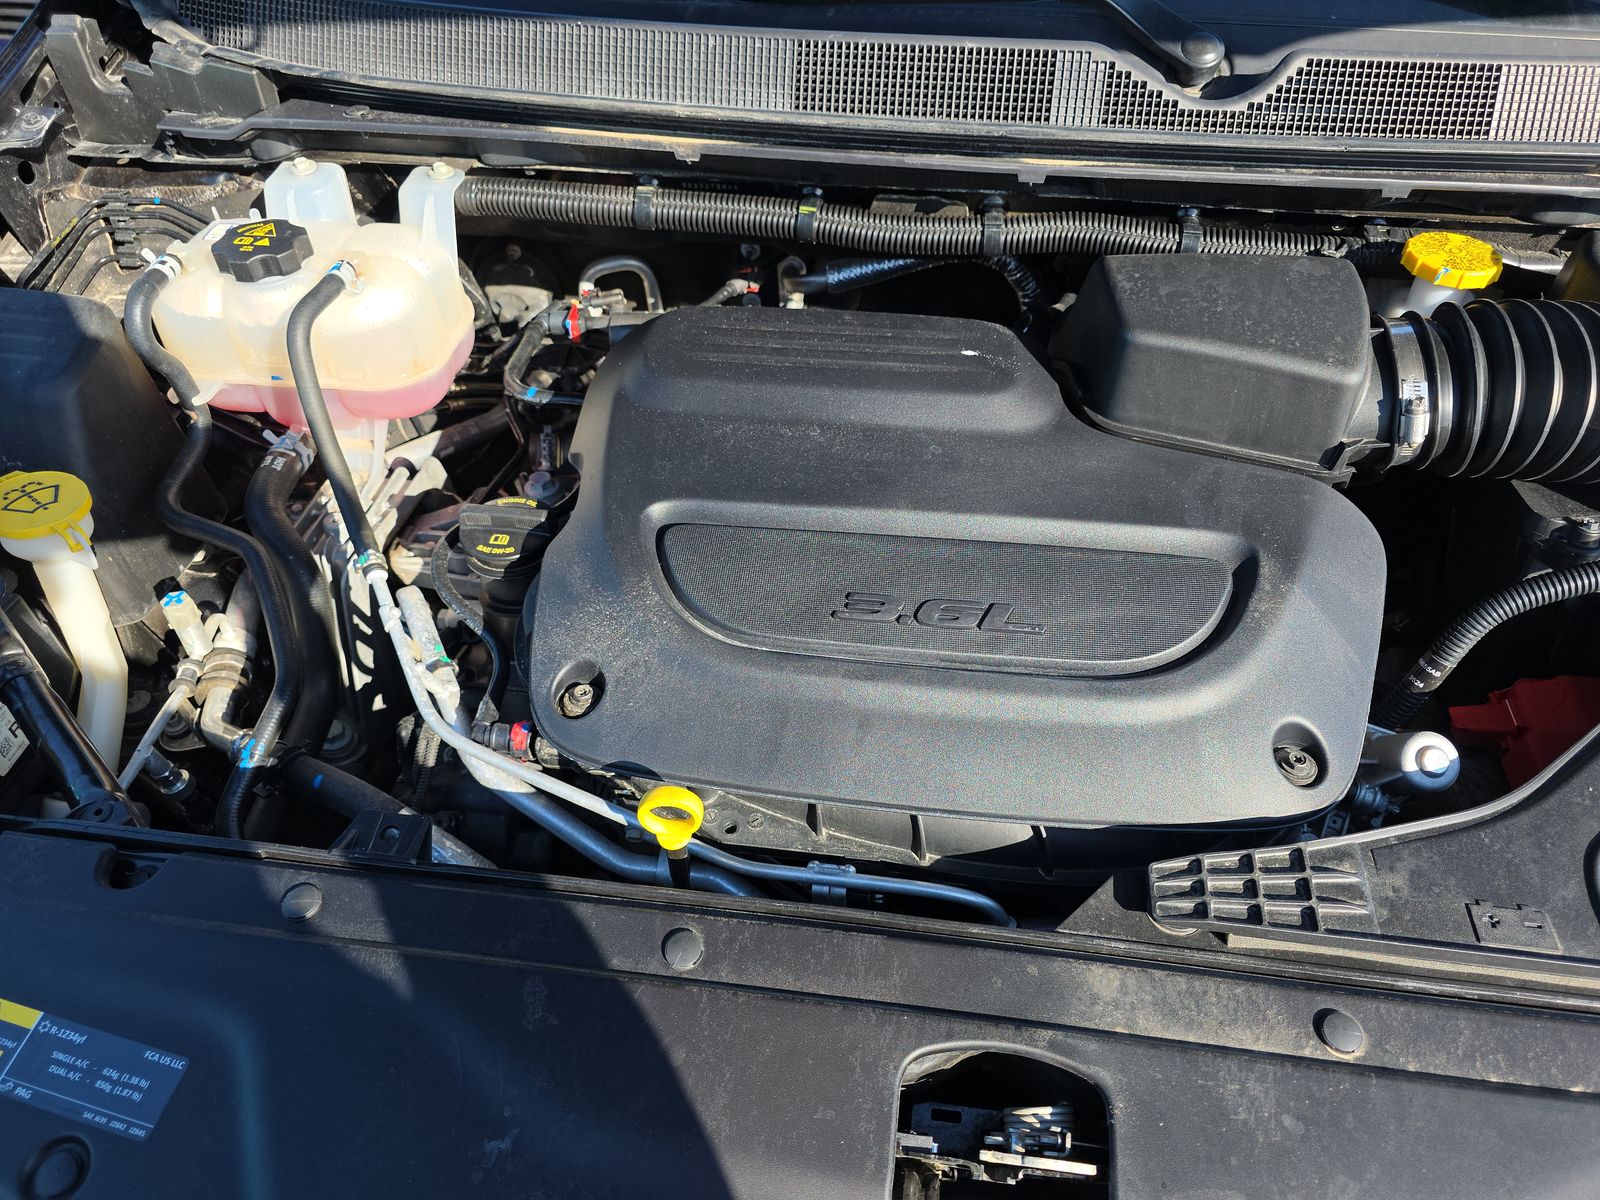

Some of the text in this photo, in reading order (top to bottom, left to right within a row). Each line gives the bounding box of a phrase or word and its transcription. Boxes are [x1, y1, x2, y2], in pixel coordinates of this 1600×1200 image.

[496, 497, 527, 505] ENGINE
[476, 544, 492, 554] SAE
[830, 591, 1048, 636] 3.6L
[49, 1025, 88, 1045] R-1234yf
[143, 1050, 186, 1070] FCA US LLC
[50, 1050, 77, 1065] SINGLE
[73, 1058, 91, 1070] A/C
[102, 1067, 121, 1081] 624g
[120, 1072, 140, 1086] (1.38
[138, 1079, 151, 1091] lb)
[14, 1086, 33, 1100] PAG
[48, 1064, 69, 1078] DUAL
[66, 1070, 83, 1082] A/C
[94, 1079, 114, 1094] 850g
[112, 1085, 133, 1098] (1.87
[131, 1091, 144, 1103] lb)
